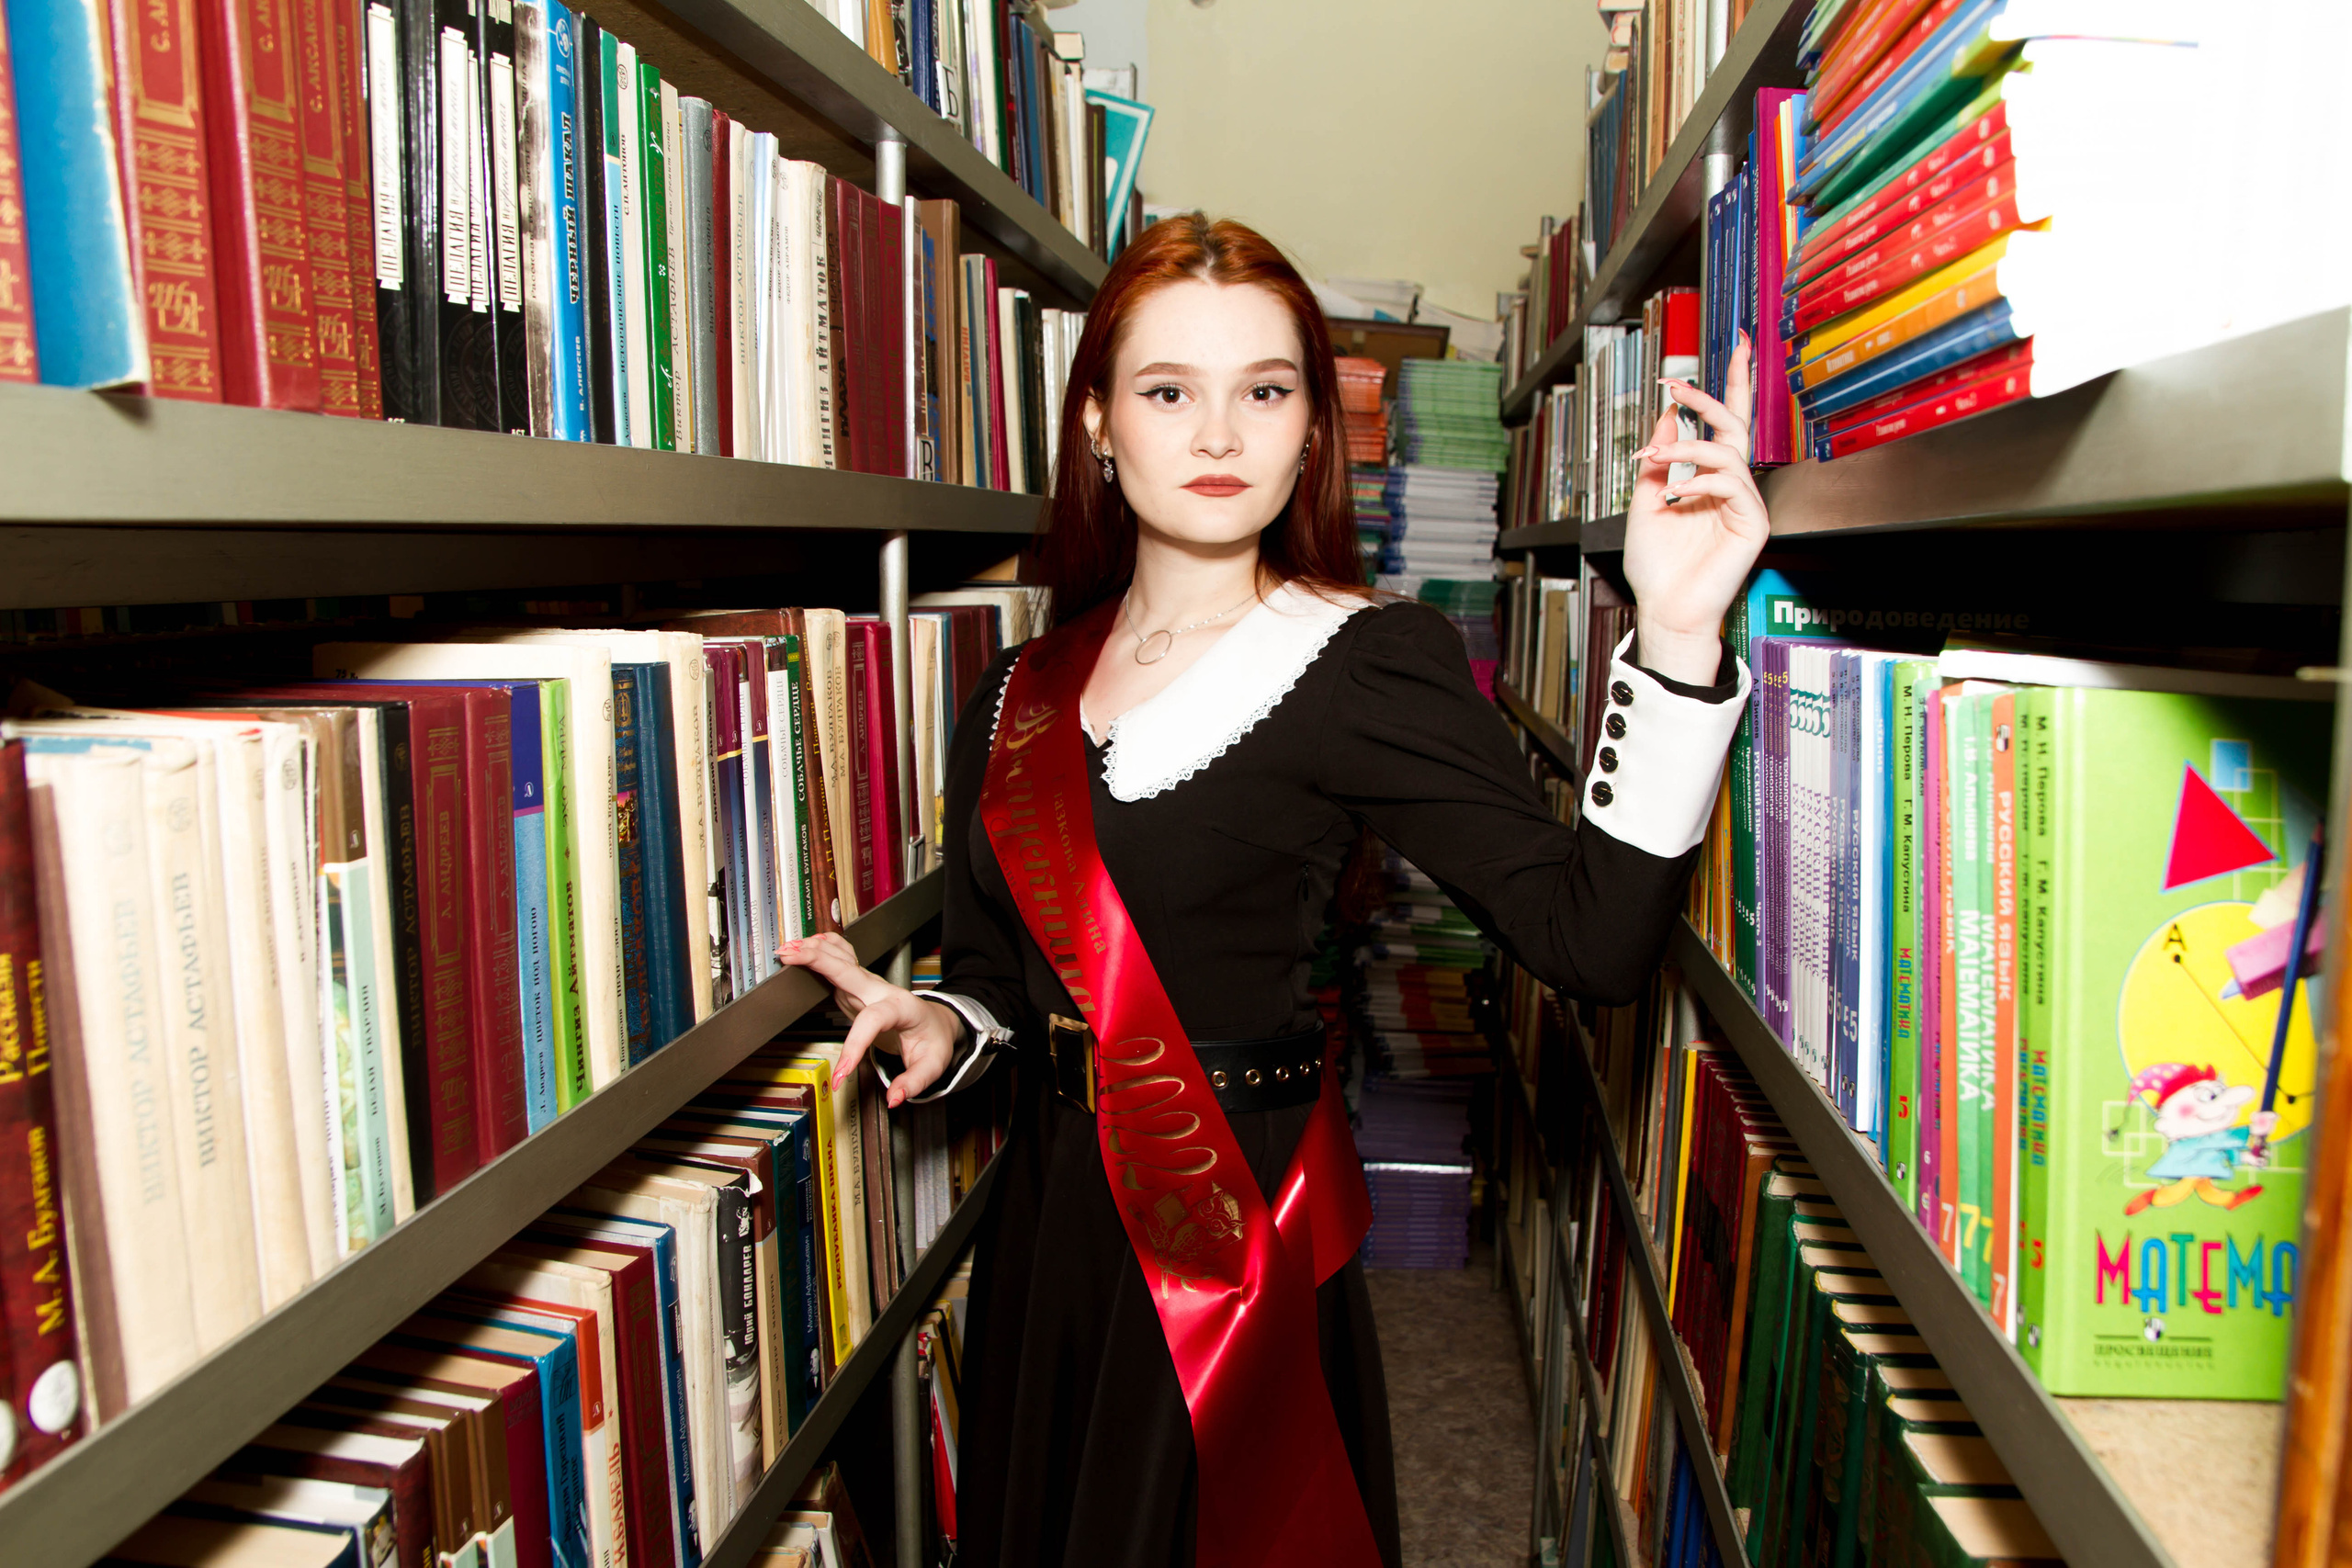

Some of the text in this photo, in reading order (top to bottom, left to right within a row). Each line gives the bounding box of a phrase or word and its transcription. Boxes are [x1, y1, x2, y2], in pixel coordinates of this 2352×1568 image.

[561, 111, 581, 304] ЧЕРНЫЙ ШАКАЛ
[620, 133, 629, 191] АНТОНОВ
[379, 192, 398, 272] ПЕЛАГИЯ
[448, 210, 465, 286] ПЕЛАГИЯ
[502, 224, 517, 295] ПЕЛАГИЯ
[612, 204, 622, 265] ПОВЕСТИ
[736, 194, 746, 365] ВИКТОР АСТАФЬЕВ
[615, 270, 626, 374] ИСТОРИЧЕСКИЕ
[669, 247, 684, 442] Виктор АСТАФЬЕВ
[816, 255, 829, 374] АЙТМАТОВ
[576, 336, 585, 412] В. АЛЕКСЕЕВ
[1773, 599, 2031, 631] Природоведение
[693, 705, 703, 808] БУЛГАКОВ
[802, 632, 836, 881] А. Платонов Повести Рассказы
[826, 669, 835, 753] БУЛГАКОВ
[834, 666, 844, 744] БУЛГАКОВ
[1752, 700, 1760, 739] Зикеев
[497, 795, 509, 877] АНДРЕЕВ
[739, 690, 762, 955] БУЛГАКОВ СОБАЧЬЕ СЕРДЦЕ
[762, 808, 770, 852] СЕРДЦЕ
[775, 676, 797, 901] БУЛГАКОВ СОБАЧЬЕ СЕРДЦЕ
[791, 682, 813, 920] МИХАИЛ БУЛГАКОВ СОБАЧЬЕ СЕРДЦЕ
[439, 810, 452, 919] Л. АНДРЕЕВ
[559, 715, 587, 1093] Чингиз Айтматов ЭХО МИРА
[1071, 881, 1107, 955] Алина
[1812, 792, 1821, 977] РУССКИЙ ЯЗЫК
[1821, 795, 1830, 983] РУССКИЙ ЯЗЫК
[1850, 809, 1860, 962] РУССКИЙ ЯЗЫК
[1896, 685, 1913, 1119] М. Н. Перова Г. М. Капустина МАТЕМАТИКА 5
[398, 804, 424, 1049] ВИКТОР АСТАФЬЕВ
[530, 908, 544, 1043] ЦВЕТОК ПОД НОГОЮ
[2162, 924, 2188, 952] А
[0, 953, 24, 1084] Рассказы
[25, 959, 52, 1077] Повести
[172, 872, 217, 1168] ВИКТОР АСТАФЬЕВ
[361, 985, 379, 1116] БЕЛАЯ ГВАРДИЯ
[1959, 771, 1980, 1247] Алышева МАТЕМАТИКА 7
[2030, 716, 2050, 1269] М. Н. Перова Г. М. Капустина МАТЕМАТИКА 5
[1993, 791, 2014, 1316] РУССКИЙ ЯЗЫК 7
[849, 1098, 862, 1207] М.А. БУЛГАКОВ
[27, 1126, 66, 1337] М. А. Булгаков
[826, 1137, 843, 1291] РЕСПУБЛИКА ШКИД
[1940, 1202, 1952, 1242] 7
[742, 1245, 755, 1346] Юрий БОНДАРЕВ
[769, 1274, 777, 1328] МАРГАРИТА
[804, 1235, 815, 1334] Михаил Афанасьевич
[675, 1368, 691, 1483] Михаил Афанасьевич
